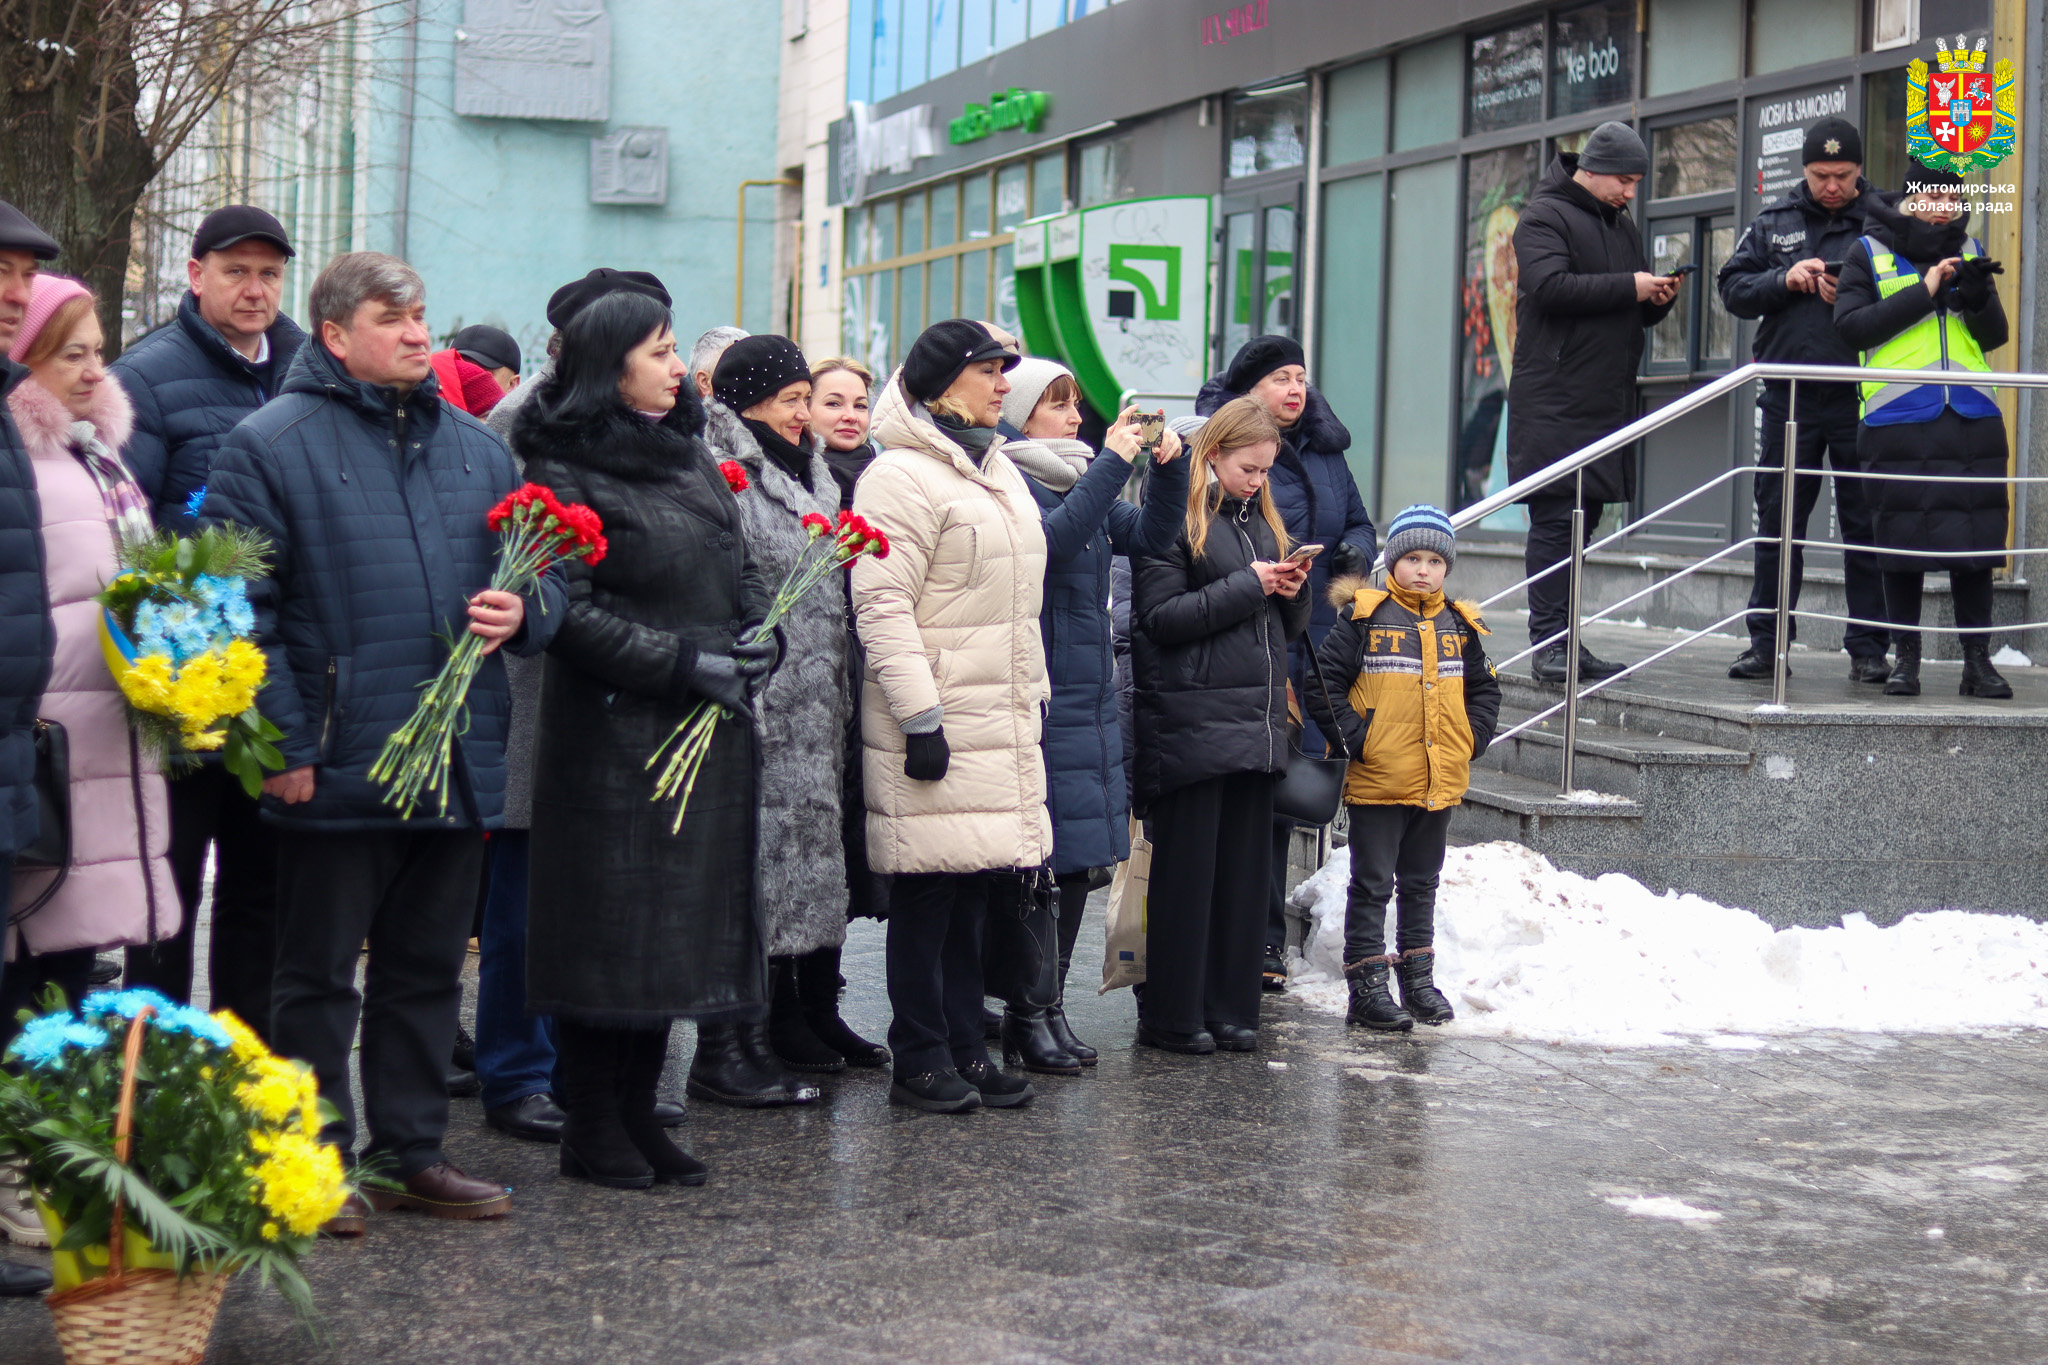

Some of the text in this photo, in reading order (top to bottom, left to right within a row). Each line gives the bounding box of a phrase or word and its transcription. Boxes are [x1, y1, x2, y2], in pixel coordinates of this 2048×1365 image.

[1589, 37, 1619, 80] bob
[1787, 101, 1794, 122] &
[1795, 85, 1847, 120] ЗАМОВЛЯЙ
[1369, 629, 1406, 653] FT
